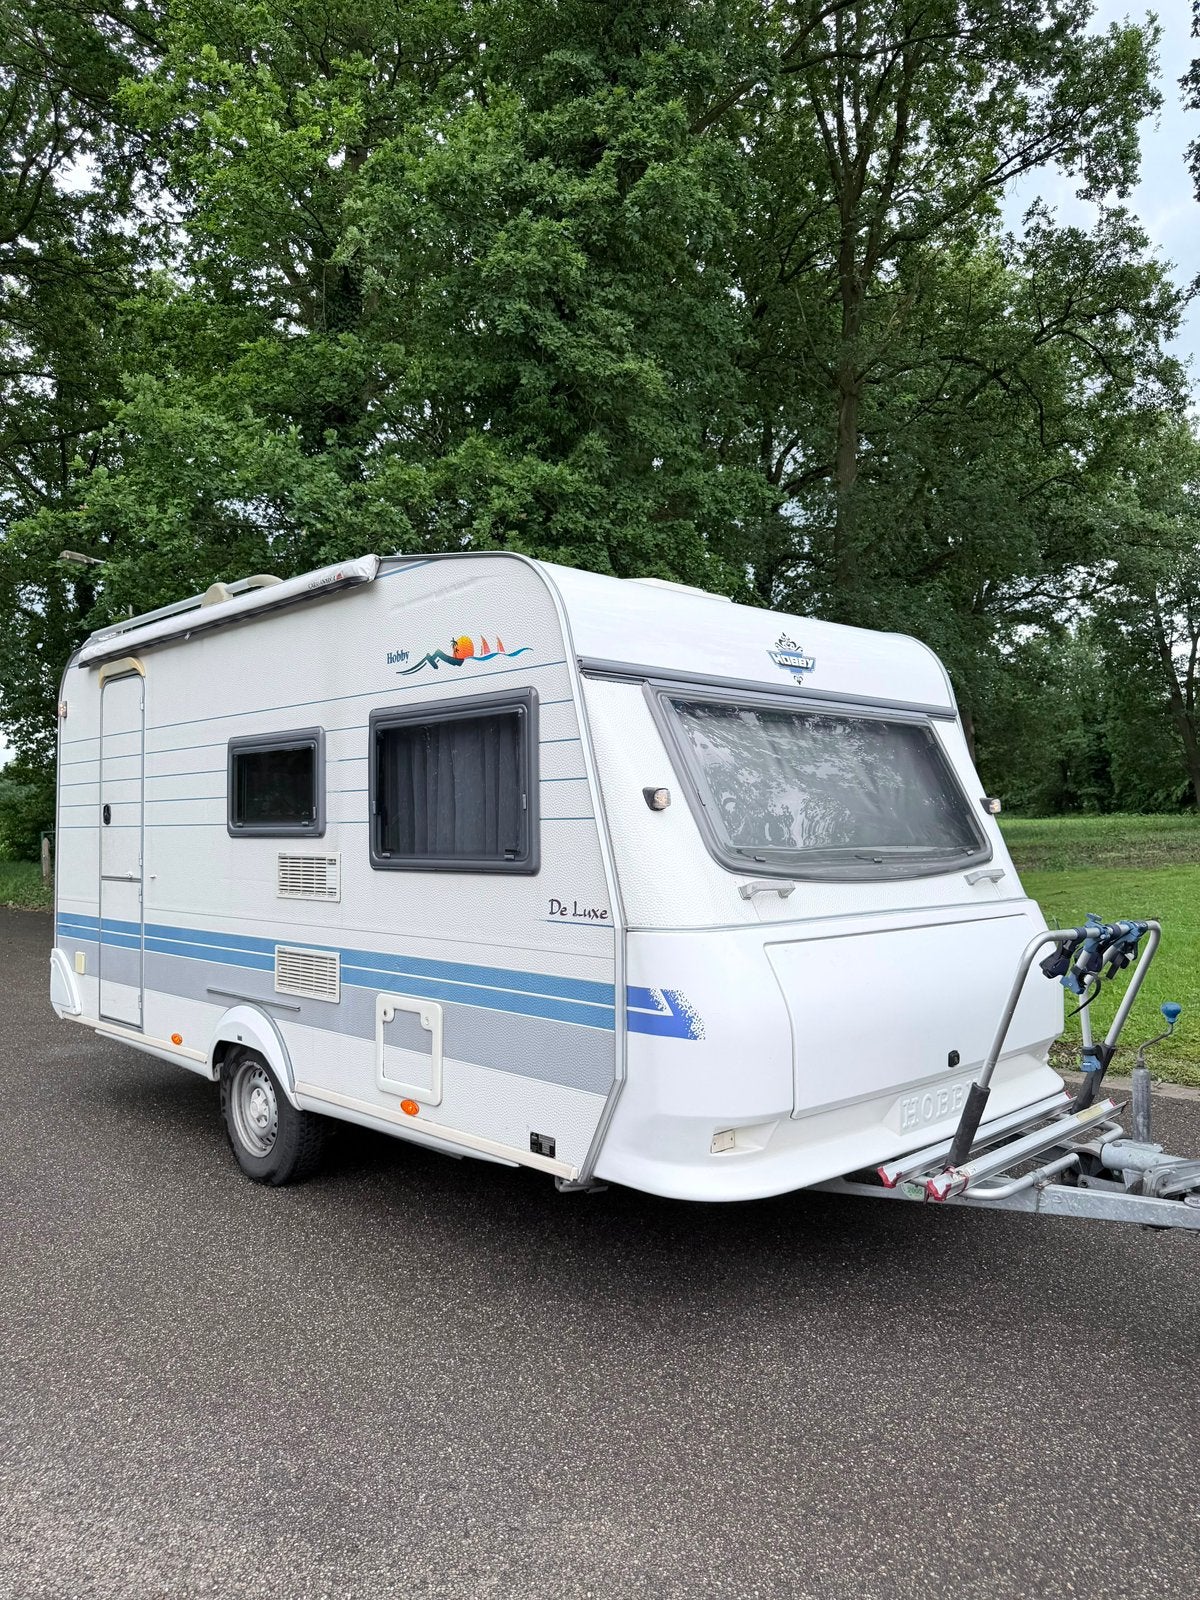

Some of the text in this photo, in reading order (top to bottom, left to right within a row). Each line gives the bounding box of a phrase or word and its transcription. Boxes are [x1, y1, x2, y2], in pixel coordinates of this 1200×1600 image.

[386, 650, 410, 664] Hobby
[769, 652, 815, 669] HOBBY
[548, 898, 609, 920] De Luxe
[901, 1079, 978, 1128] HOBB
